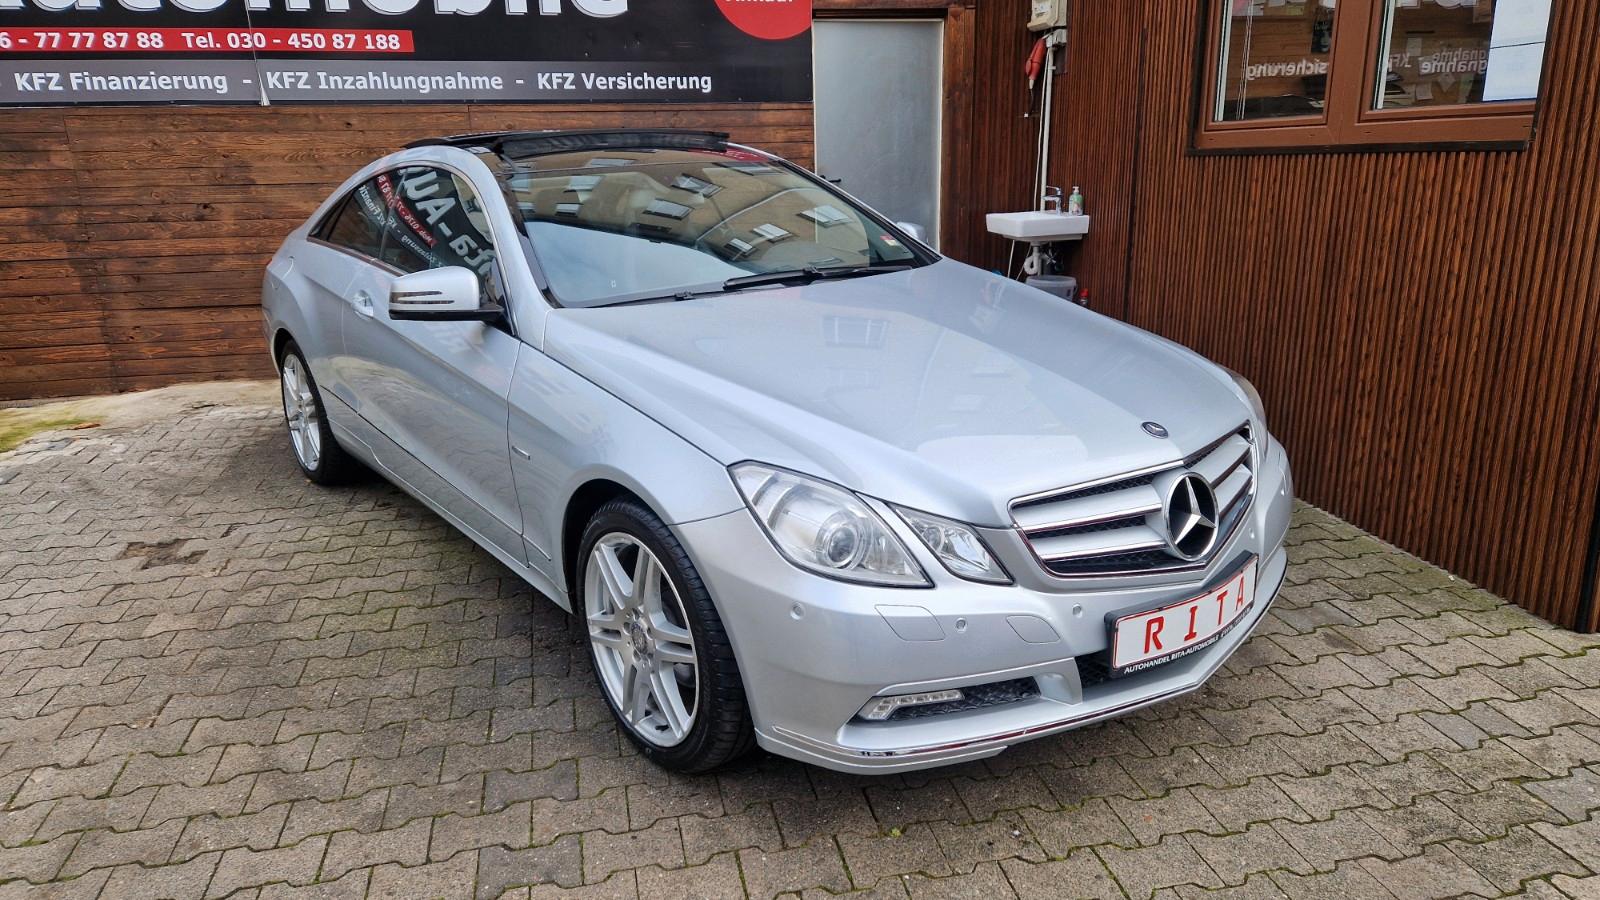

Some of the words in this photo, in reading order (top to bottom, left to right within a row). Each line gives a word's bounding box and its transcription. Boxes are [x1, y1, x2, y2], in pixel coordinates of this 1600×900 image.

[34, 32, 62, 48] 77
[68, 32, 96, 48] 77
[102, 32, 130, 48] 87
[137, 32, 164, 48] 88
[181, 32, 221, 48] Tel.
[227, 32, 266, 49] 030
[287, 33, 326, 49] 450
[332, 33, 357, 49] 87
[364, 34, 401, 50] 188
[14, 72, 64, 91] KFZ
[69, 71, 229, 94] Finanzierung
[266, 71, 311, 89] KFZ
[317, 71, 503, 93] Inzahlungnahme
[537, 72, 577, 90] KFZ
[581, 71, 713, 93] Versicherung
[1123, 655, 1171, 675] AUTOHANDEL
